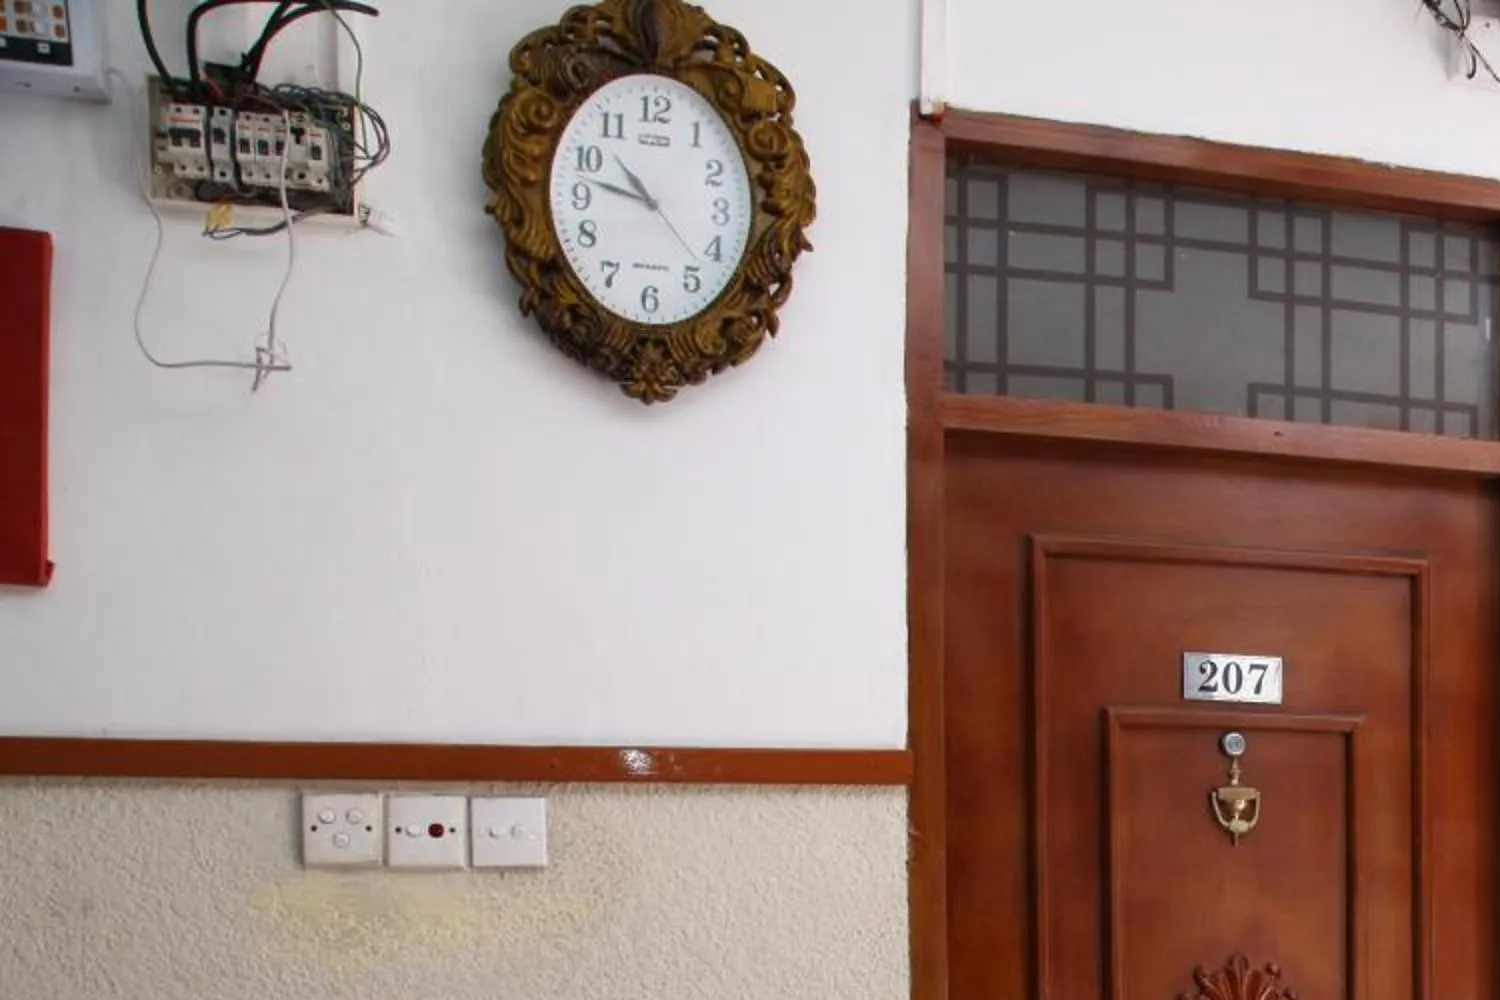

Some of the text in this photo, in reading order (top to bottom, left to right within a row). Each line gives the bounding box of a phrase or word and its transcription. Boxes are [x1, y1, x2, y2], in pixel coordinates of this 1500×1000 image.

[639, 96, 671, 124] 12
[601, 112, 625, 139] 11
[689, 122, 702, 148] 1
[575, 145, 602, 173] 10
[705, 160, 723, 187] 2
[572, 182, 591, 211] 9
[712, 200, 730, 226] 3
[578, 220, 596, 248] 8
[705, 236, 723, 262] 4
[601, 261, 620, 288] 7
[684, 265, 700, 293] 5
[641, 286, 658, 313] 6
[1198, 660, 1268, 695] 207
